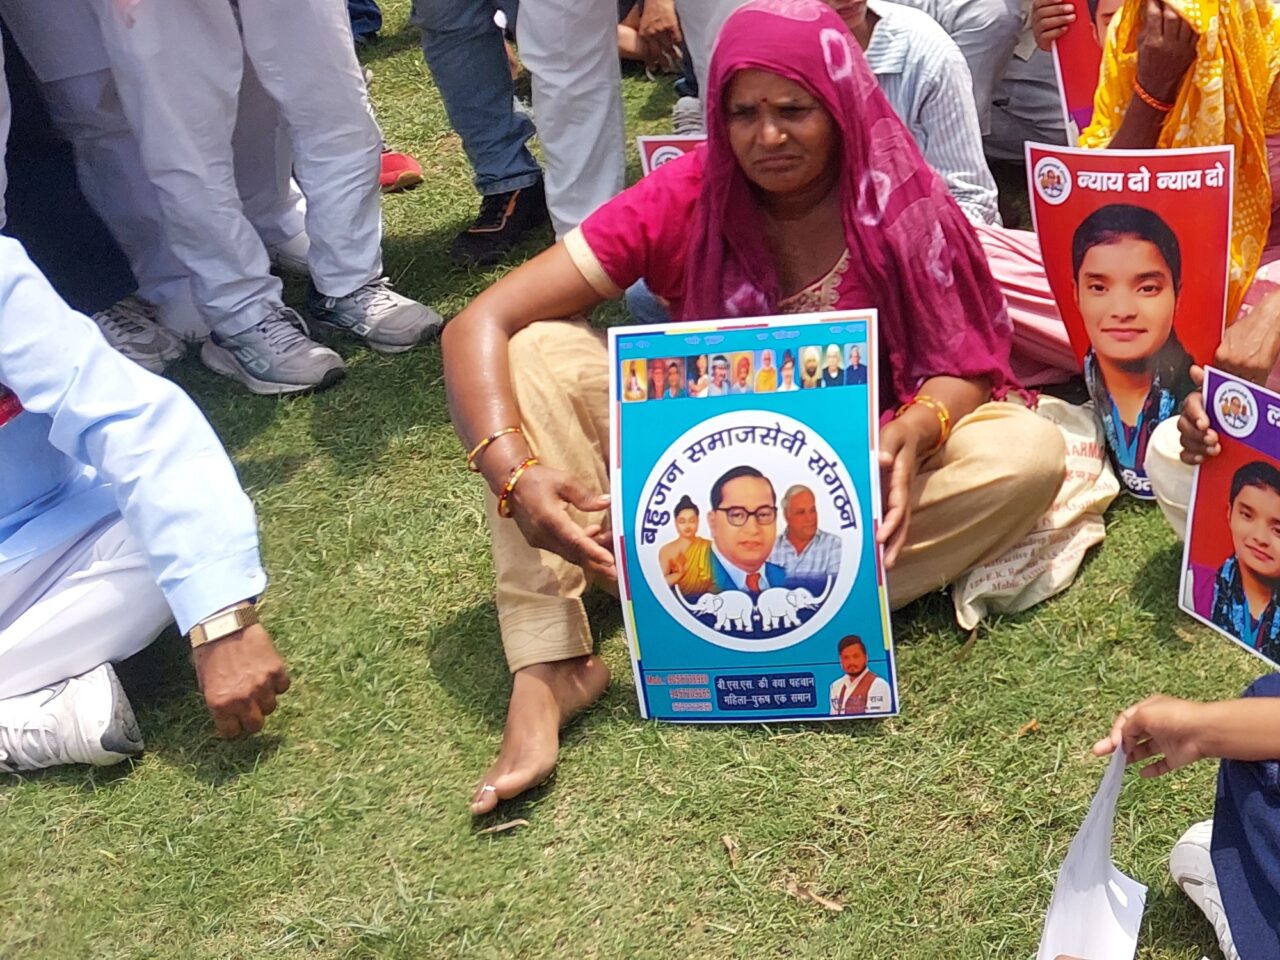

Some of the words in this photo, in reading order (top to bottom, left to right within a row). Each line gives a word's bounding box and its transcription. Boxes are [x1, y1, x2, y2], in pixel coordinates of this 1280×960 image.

[1077, 171, 1125, 192] न्याय
[1127, 166, 1151, 192] दो
[1156, 169, 1202, 191] न्याय
[1205, 161, 1225, 187] दो
[640, 459, 685, 546] बहुजन
[682, 422, 808, 463] समाजसेवी
